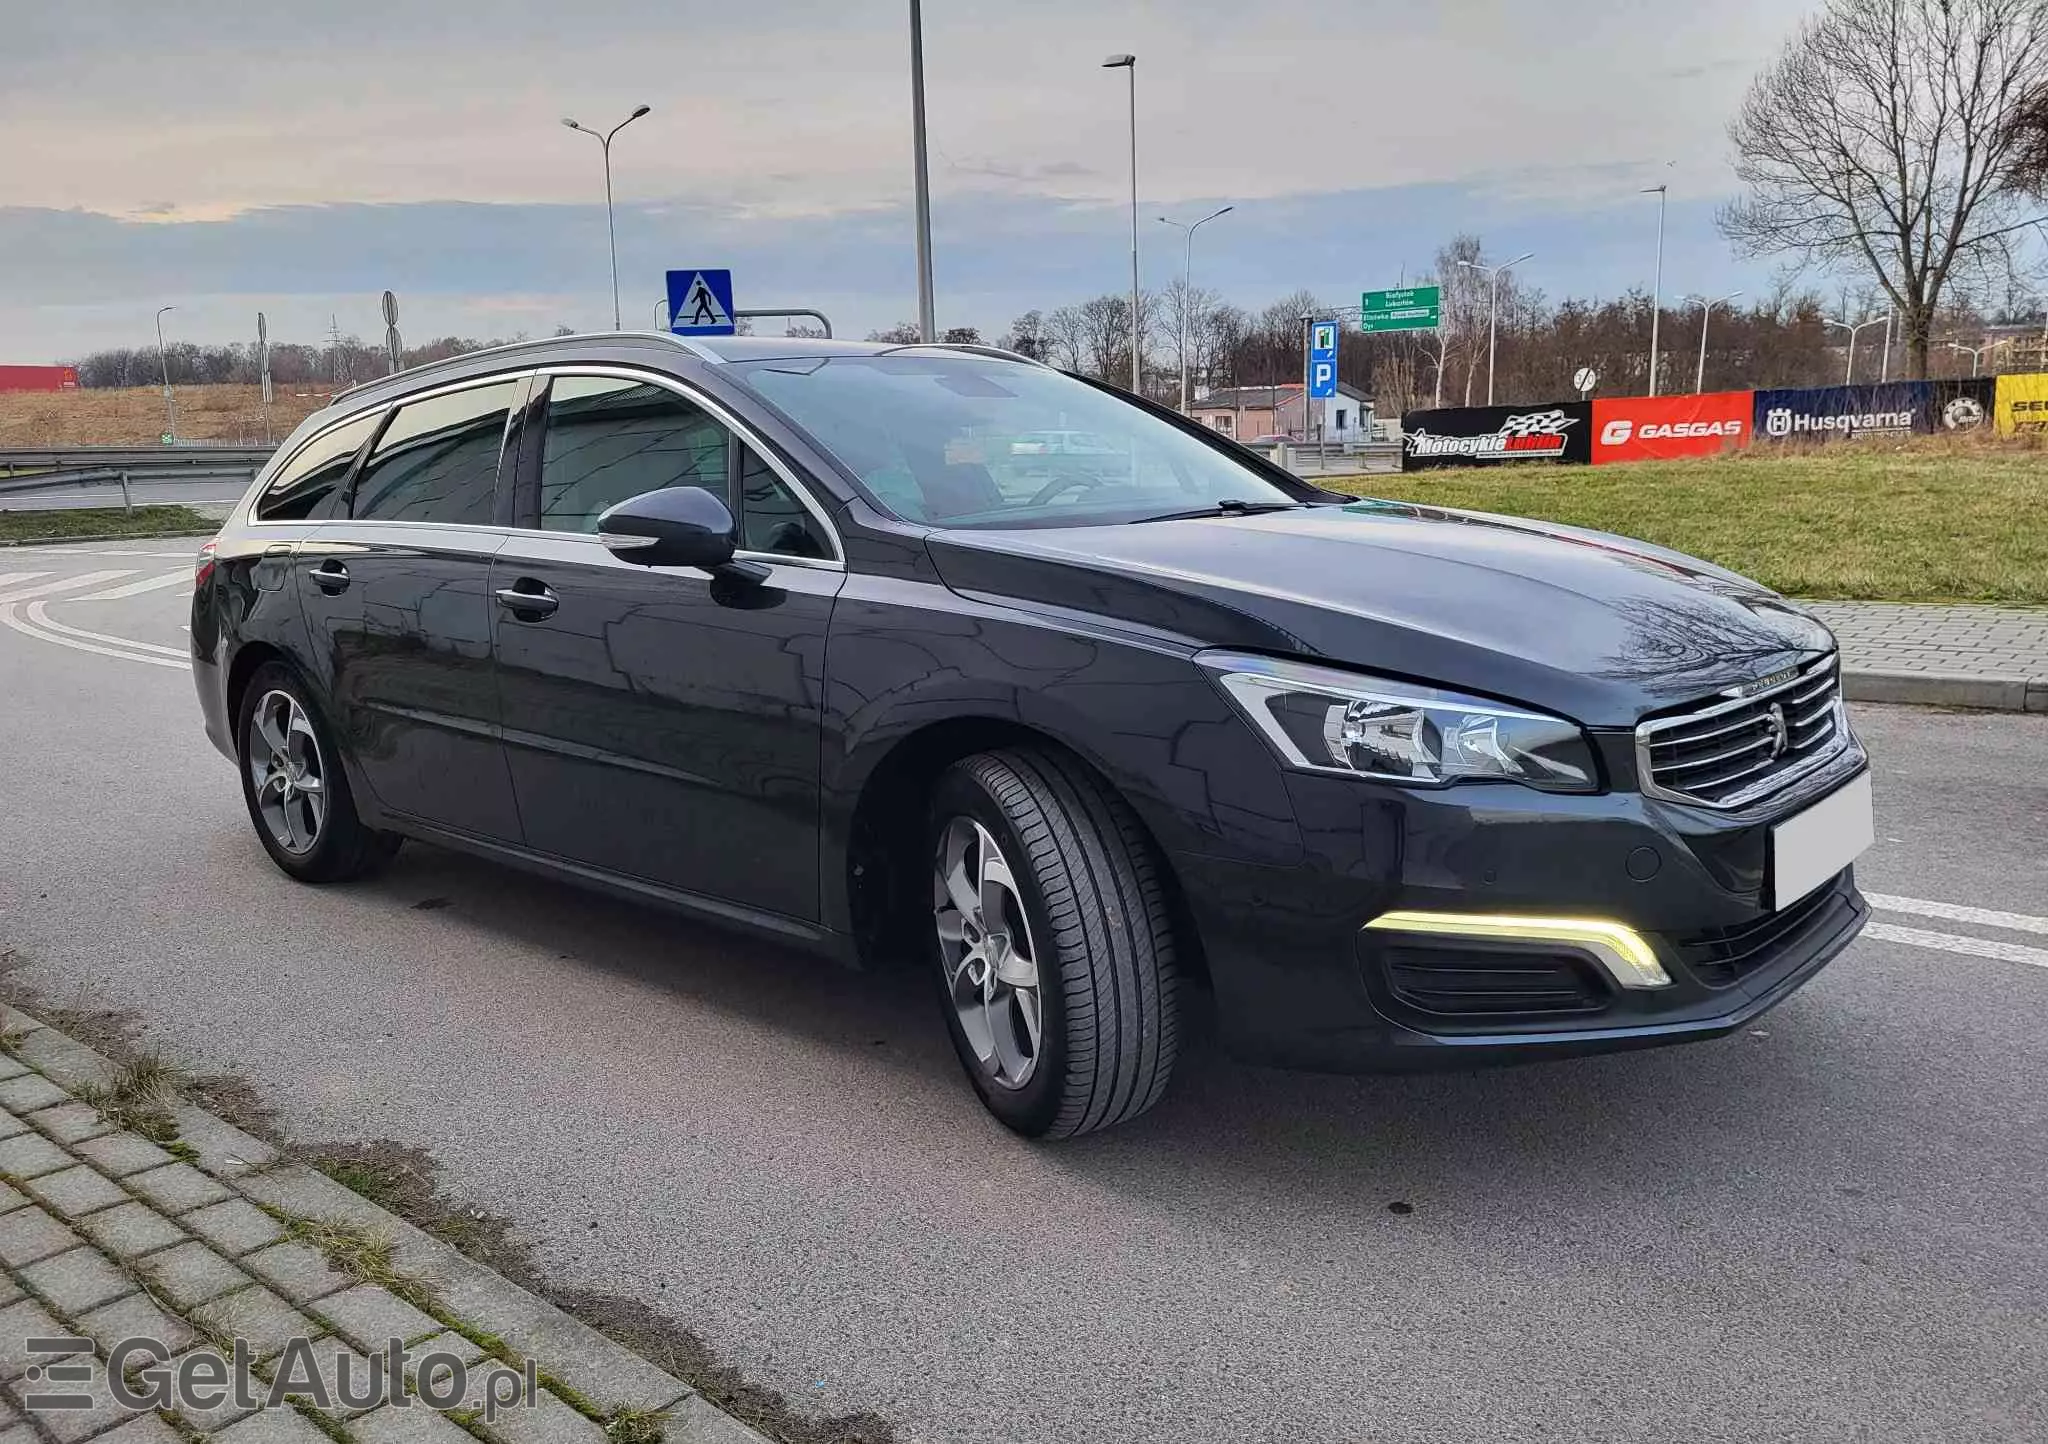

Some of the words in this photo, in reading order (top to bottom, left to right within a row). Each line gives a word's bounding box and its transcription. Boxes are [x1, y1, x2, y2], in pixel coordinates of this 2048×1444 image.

[1316, 364, 1331, 388] P
[1639, 421, 1742, 439] GASGAS
[1794, 411, 1912, 432] Husqvarna
